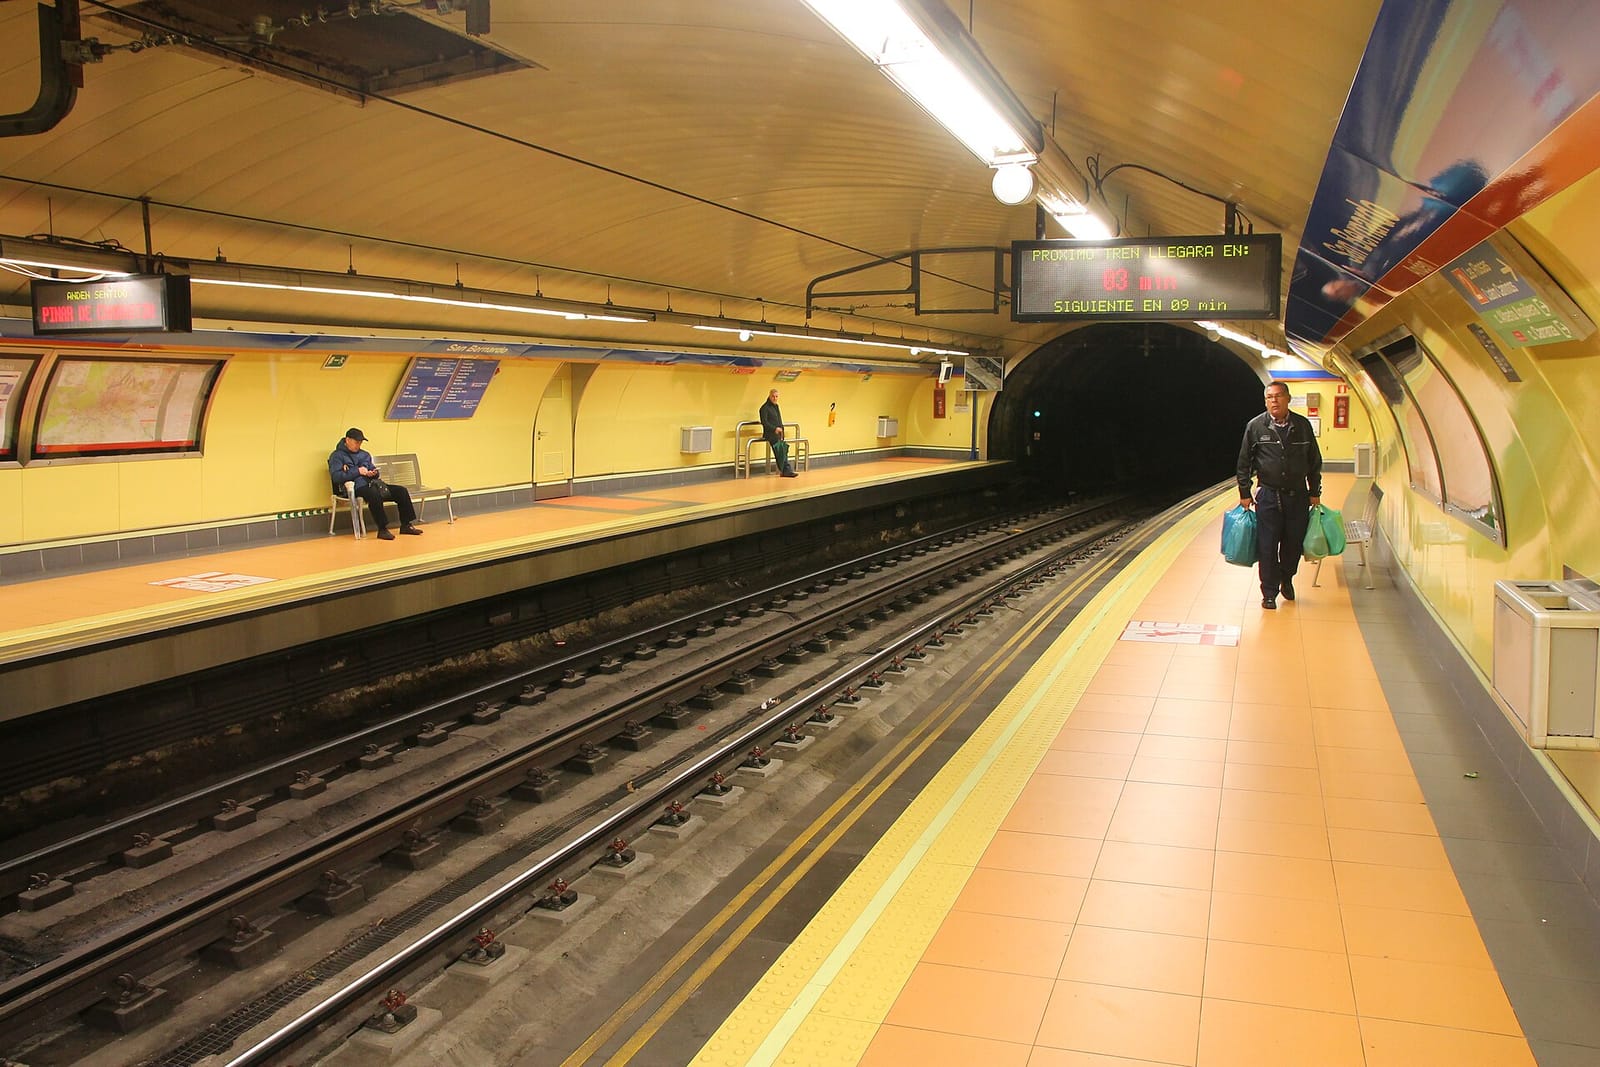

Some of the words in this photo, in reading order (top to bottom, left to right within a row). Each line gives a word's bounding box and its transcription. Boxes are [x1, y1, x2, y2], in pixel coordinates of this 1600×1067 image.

[1330, 198, 1400, 253] Bernardo
[1032, 249, 1095, 262] PROXIMO
[1104, 247, 1140, 260] TREN
[1148, 245, 1214, 258] LLEGARA
[1223, 244, 1249, 257] EN:
[1322, 239, 1369, 265] San
[1103, 268, 1129, 292] 03
[1138, 271, 1177, 290] min
[66, 290, 91, 301] ANDEN
[1054, 300, 1134, 313] SIGUIENTE
[1143, 299, 1162, 312] EN
[1170, 299, 1190, 311] 09
[1198, 298, 1227, 311] min
[446, 343, 467, 352] San
